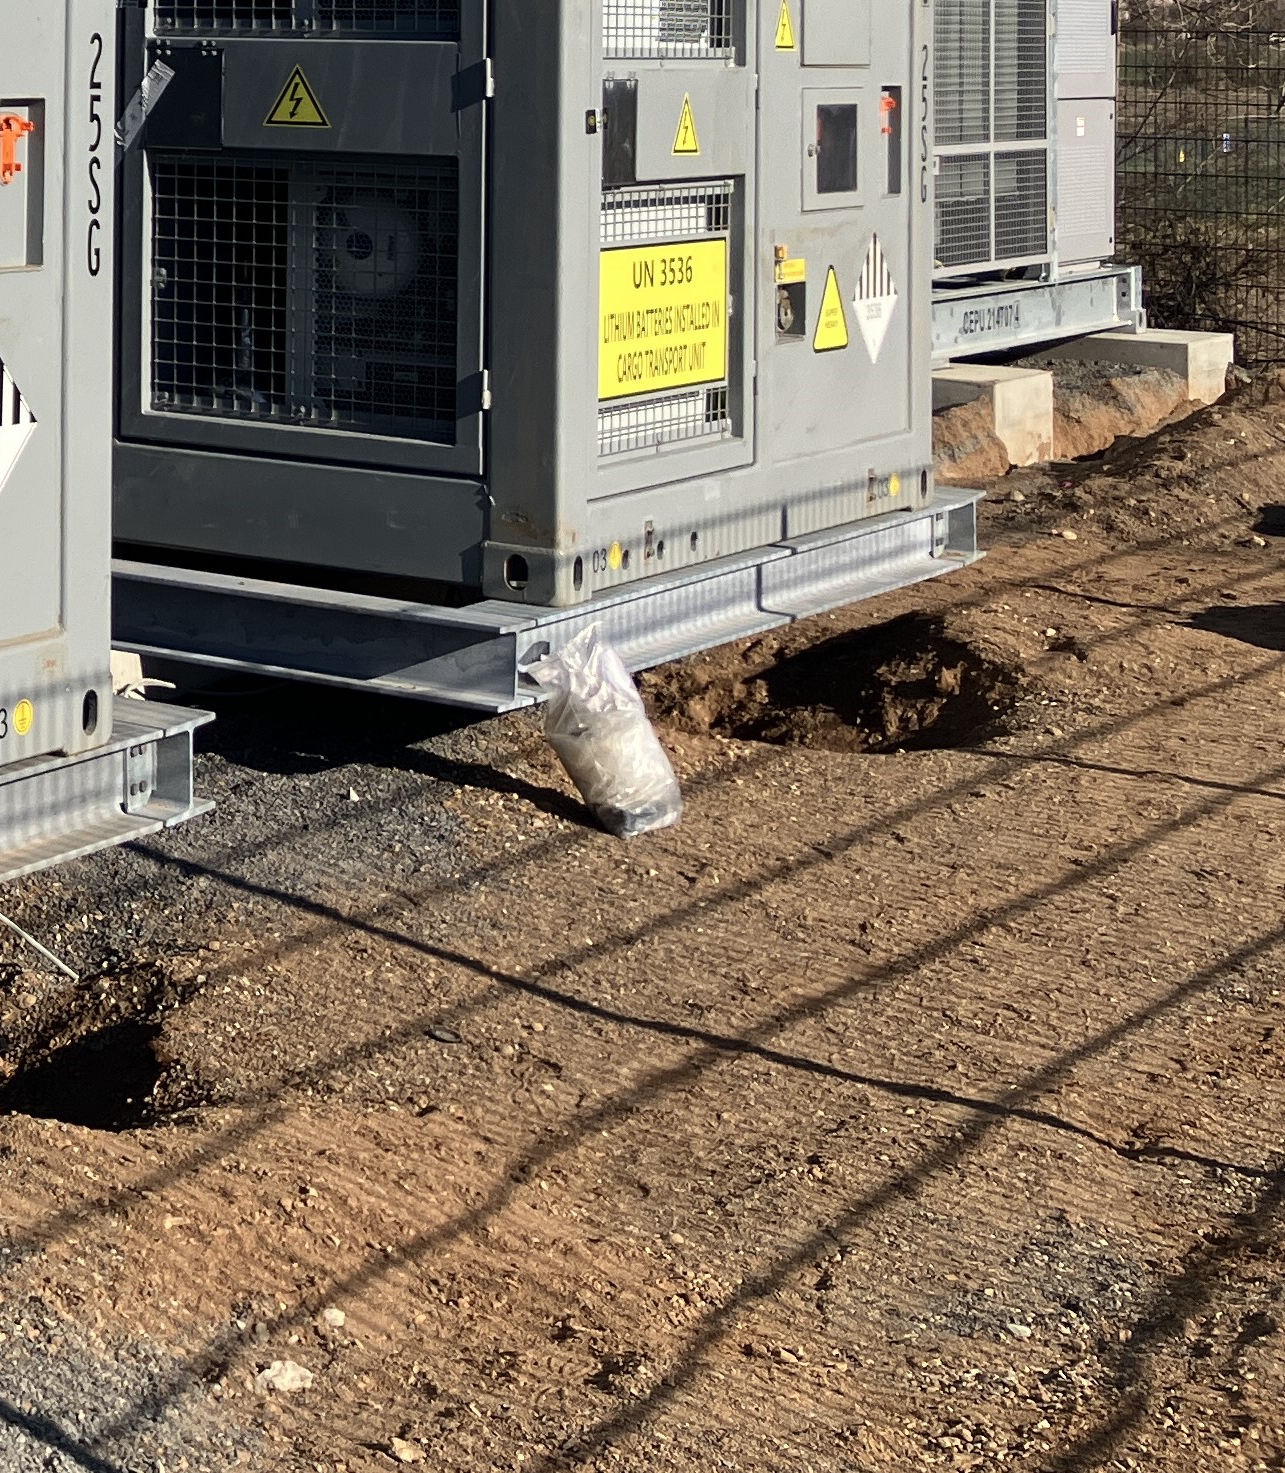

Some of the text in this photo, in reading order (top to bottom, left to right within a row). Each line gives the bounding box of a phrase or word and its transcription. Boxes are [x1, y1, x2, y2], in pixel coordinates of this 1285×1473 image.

[87, 33, 103, 277] 25SG
[633, 255, 693, 289] UN 3536
[603, 299, 720, 343] LITHIUM BATTERIES INSTALLED IN
[617, 341, 707, 383] CARGO TRANSPORT UNIT
[592, 548, 607, 573] 03
